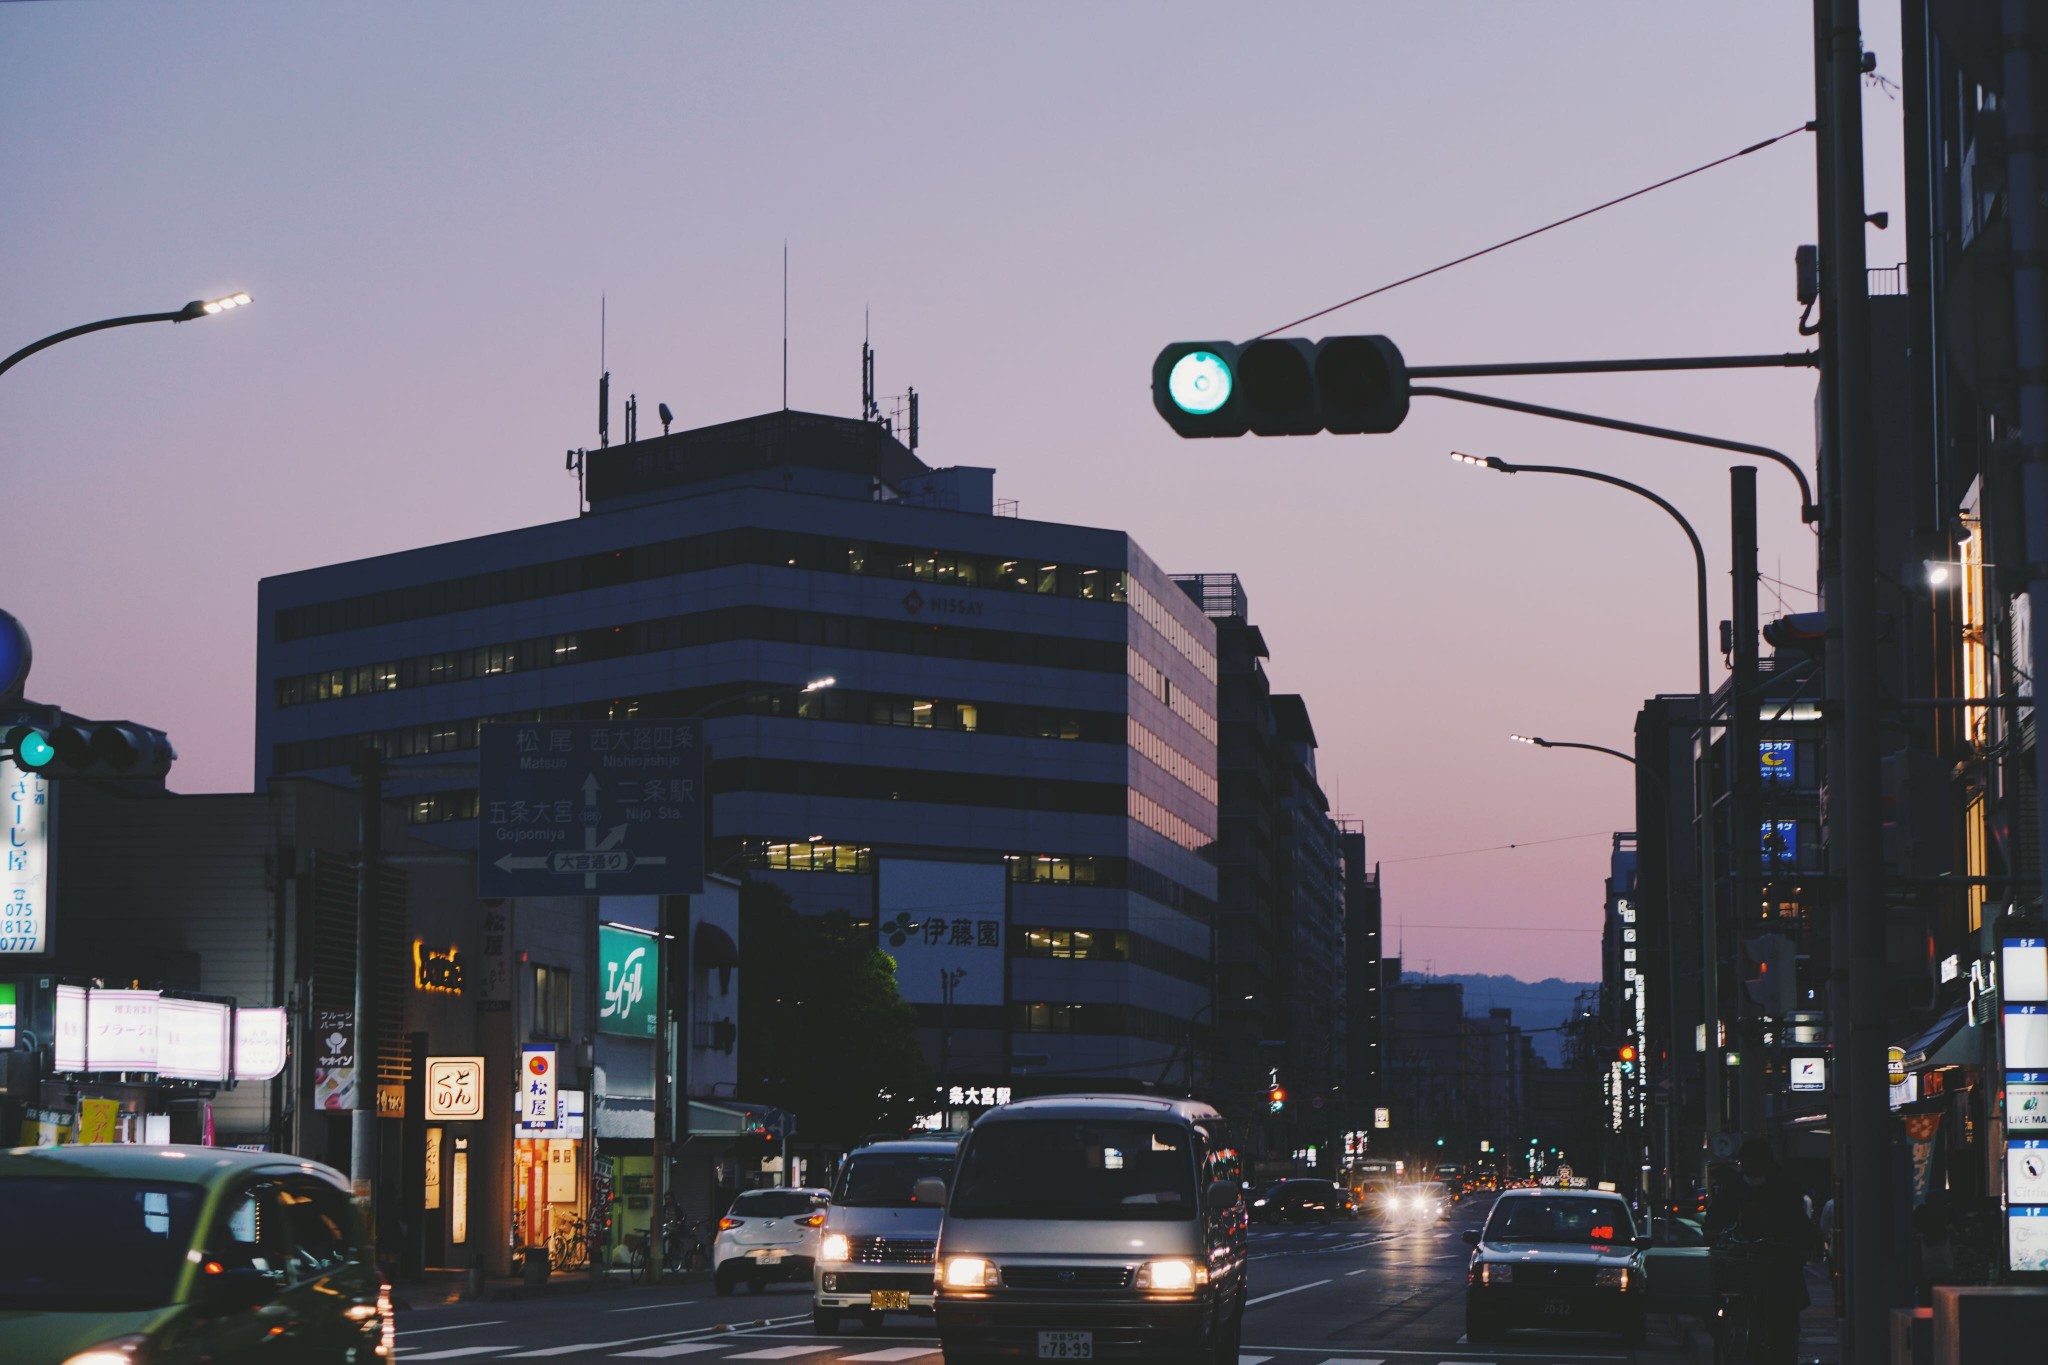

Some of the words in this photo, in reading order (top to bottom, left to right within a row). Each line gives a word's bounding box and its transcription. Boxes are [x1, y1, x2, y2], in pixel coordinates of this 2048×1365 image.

[929, 597, 983, 616] NISSAY
[590, 726, 693, 751] 西大路四条
[520, 757, 568, 769] Matsuo
[603, 754, 680, 769] Nishiojishijo
[616, 778, 695, 803] 二条駅
[488, 801, 573, 824] 五条大宮
[626, 807, 651, 822] Nijo
[496, 827, 565, 842] Gojoomiya
[560, 855, 622, 869] 大宮通り
[6, 904, 32, 916] 075
[0, 920, 37, 934] (812)
[921, 917, 999, 948] 伊藤園
[0, 937, 37, 950] 0777
[2020, 939, 2035, 947] 5F
[321, 1012, 352, 1020] フルーツ
[2021, 1006, 2036, 1014] 4F
[320, 1021, 352, 1029] パーラー
[319, 1055, 353, 1066] ヤオイソ
[2023, 1072, 2038, 1081] 3F
[530, 1080, 547, 1116] 松屋
[2032, 1116, 2048, 1124] MA
[2024, 1140, 2039, 1148] 2F
[2026, 1208, 2041, 1216] 1F
[1049, 1342, 1090, 1357] 78-99
